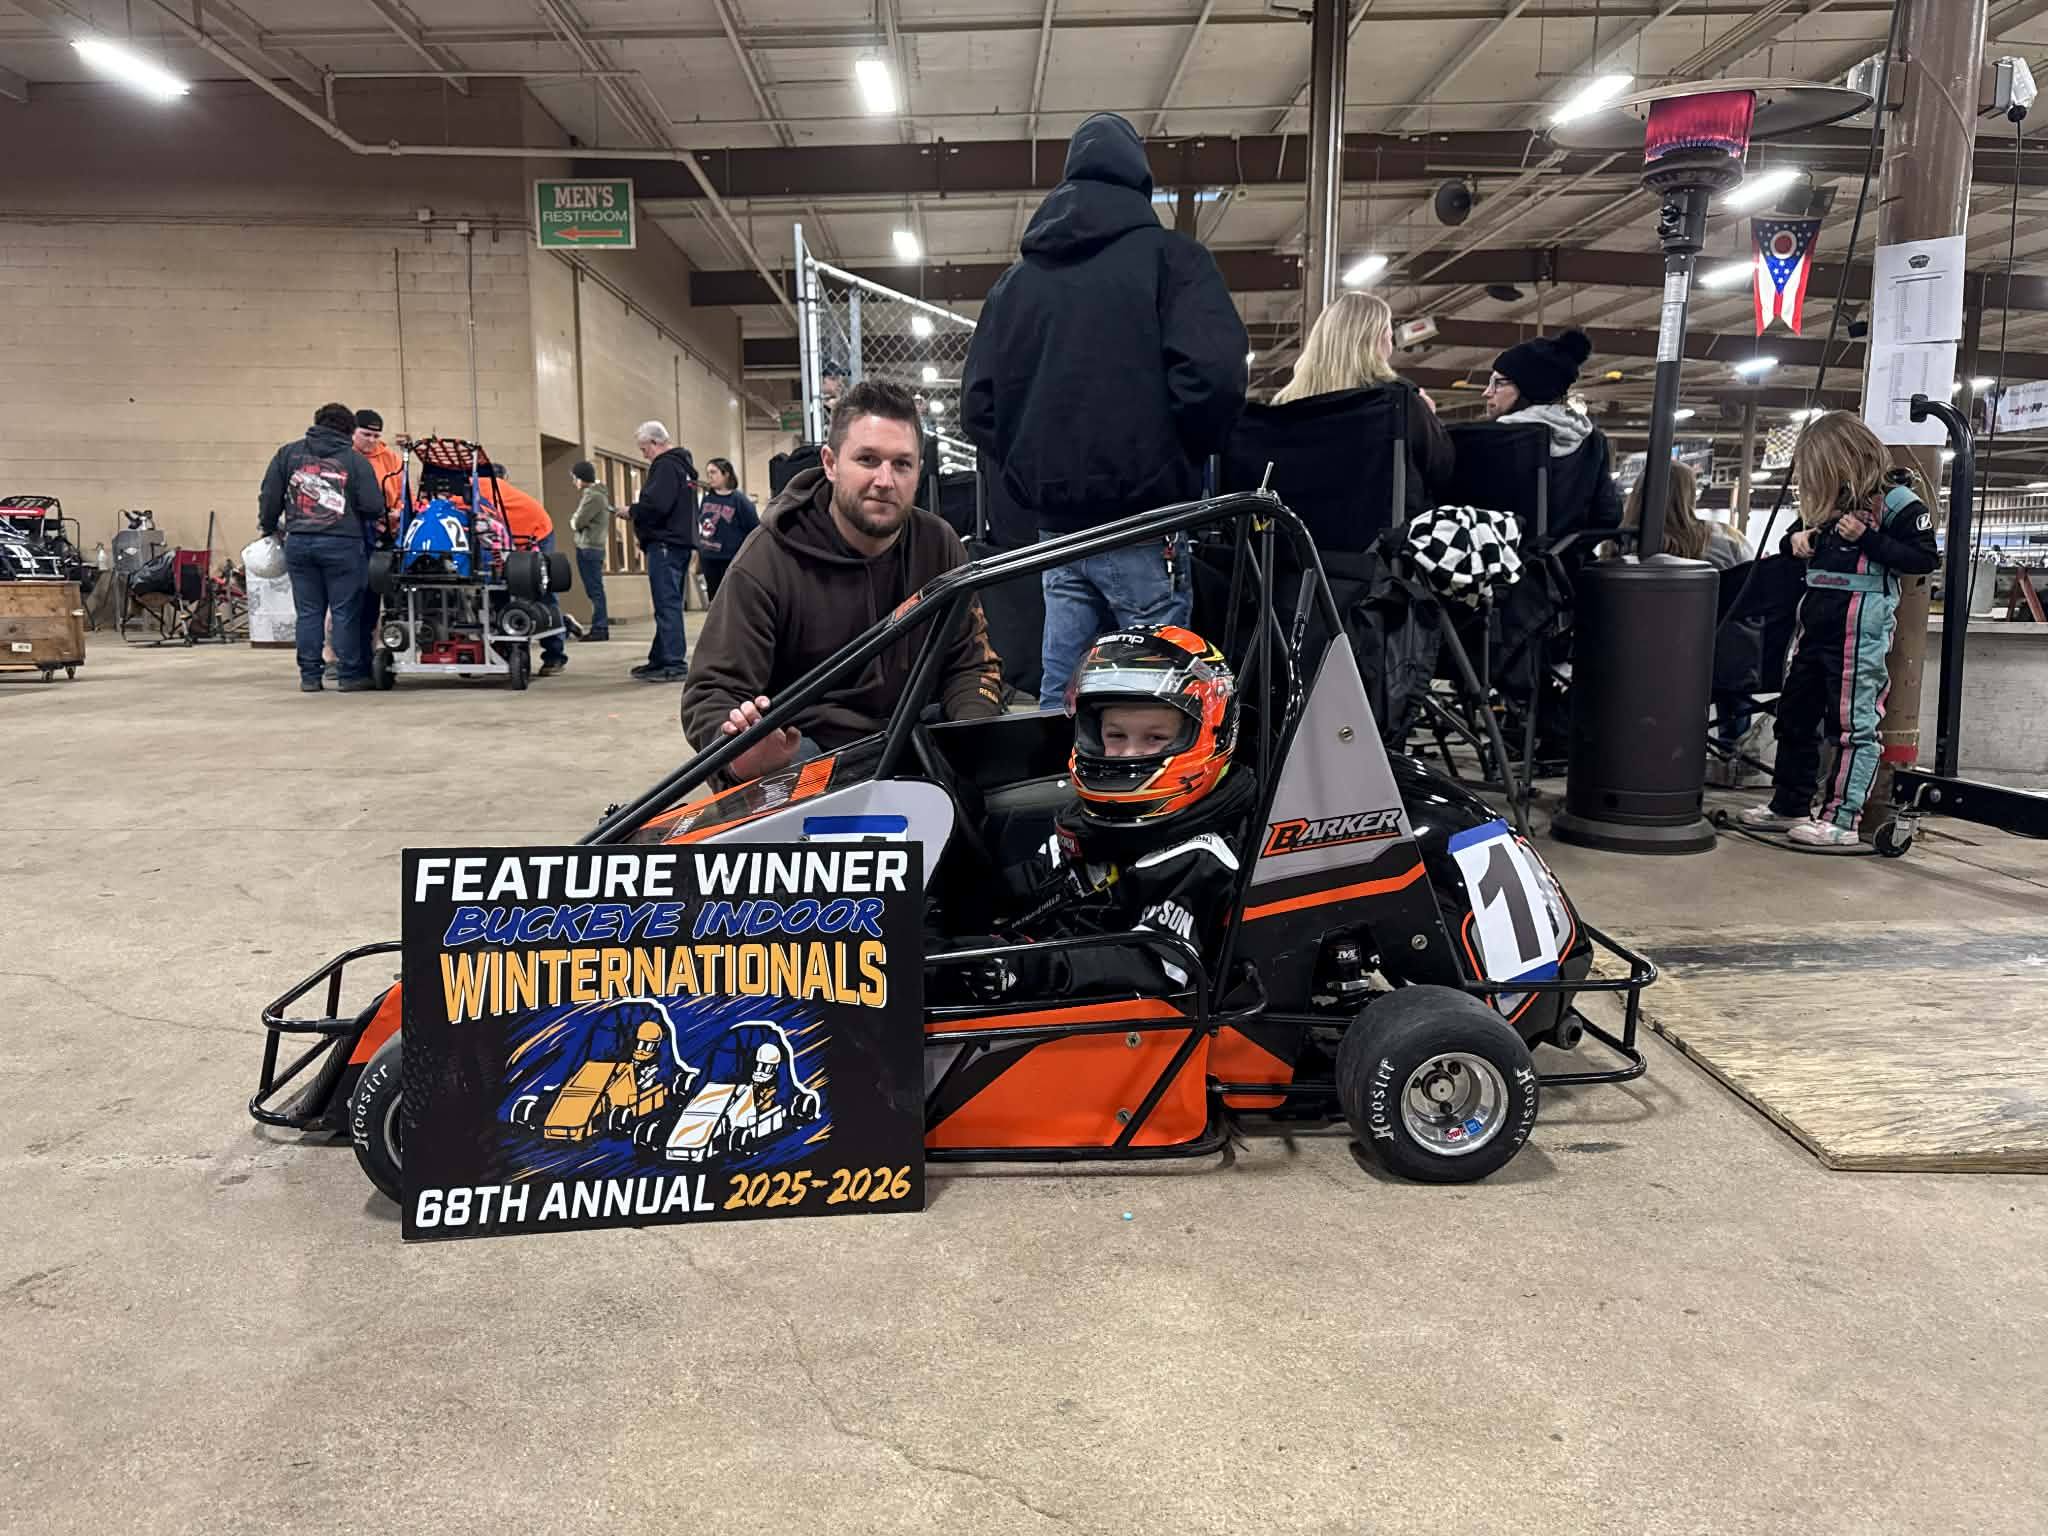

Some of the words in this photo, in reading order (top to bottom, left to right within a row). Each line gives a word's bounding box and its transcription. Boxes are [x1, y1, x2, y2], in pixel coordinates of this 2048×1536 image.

[543, 210, 627, 222] RESTROOM
[553, 186, 615, 208] MEN'S
[446, 519, 467, 548] 2
[1262, 808, 1402, 857] BARKER
[415, 855, 676, 902] FEATURE
[695, 850, 909, 896] WINNER
[443, 902, 684, 946] BUCKEYE
[694, 898, 884, 939] INDOOR
[1478, 843, 1543, 964] 1
[440, 940, 888, 1023] WINTERNATIONALS
[1369, 1057, 1396, 1142] Hoosier
[416, 1184, 528, 1228] 68TH
[538, 1175, 715, 1222] ANNUAL
[723, 1166, 912, 1211] 2025-2026
